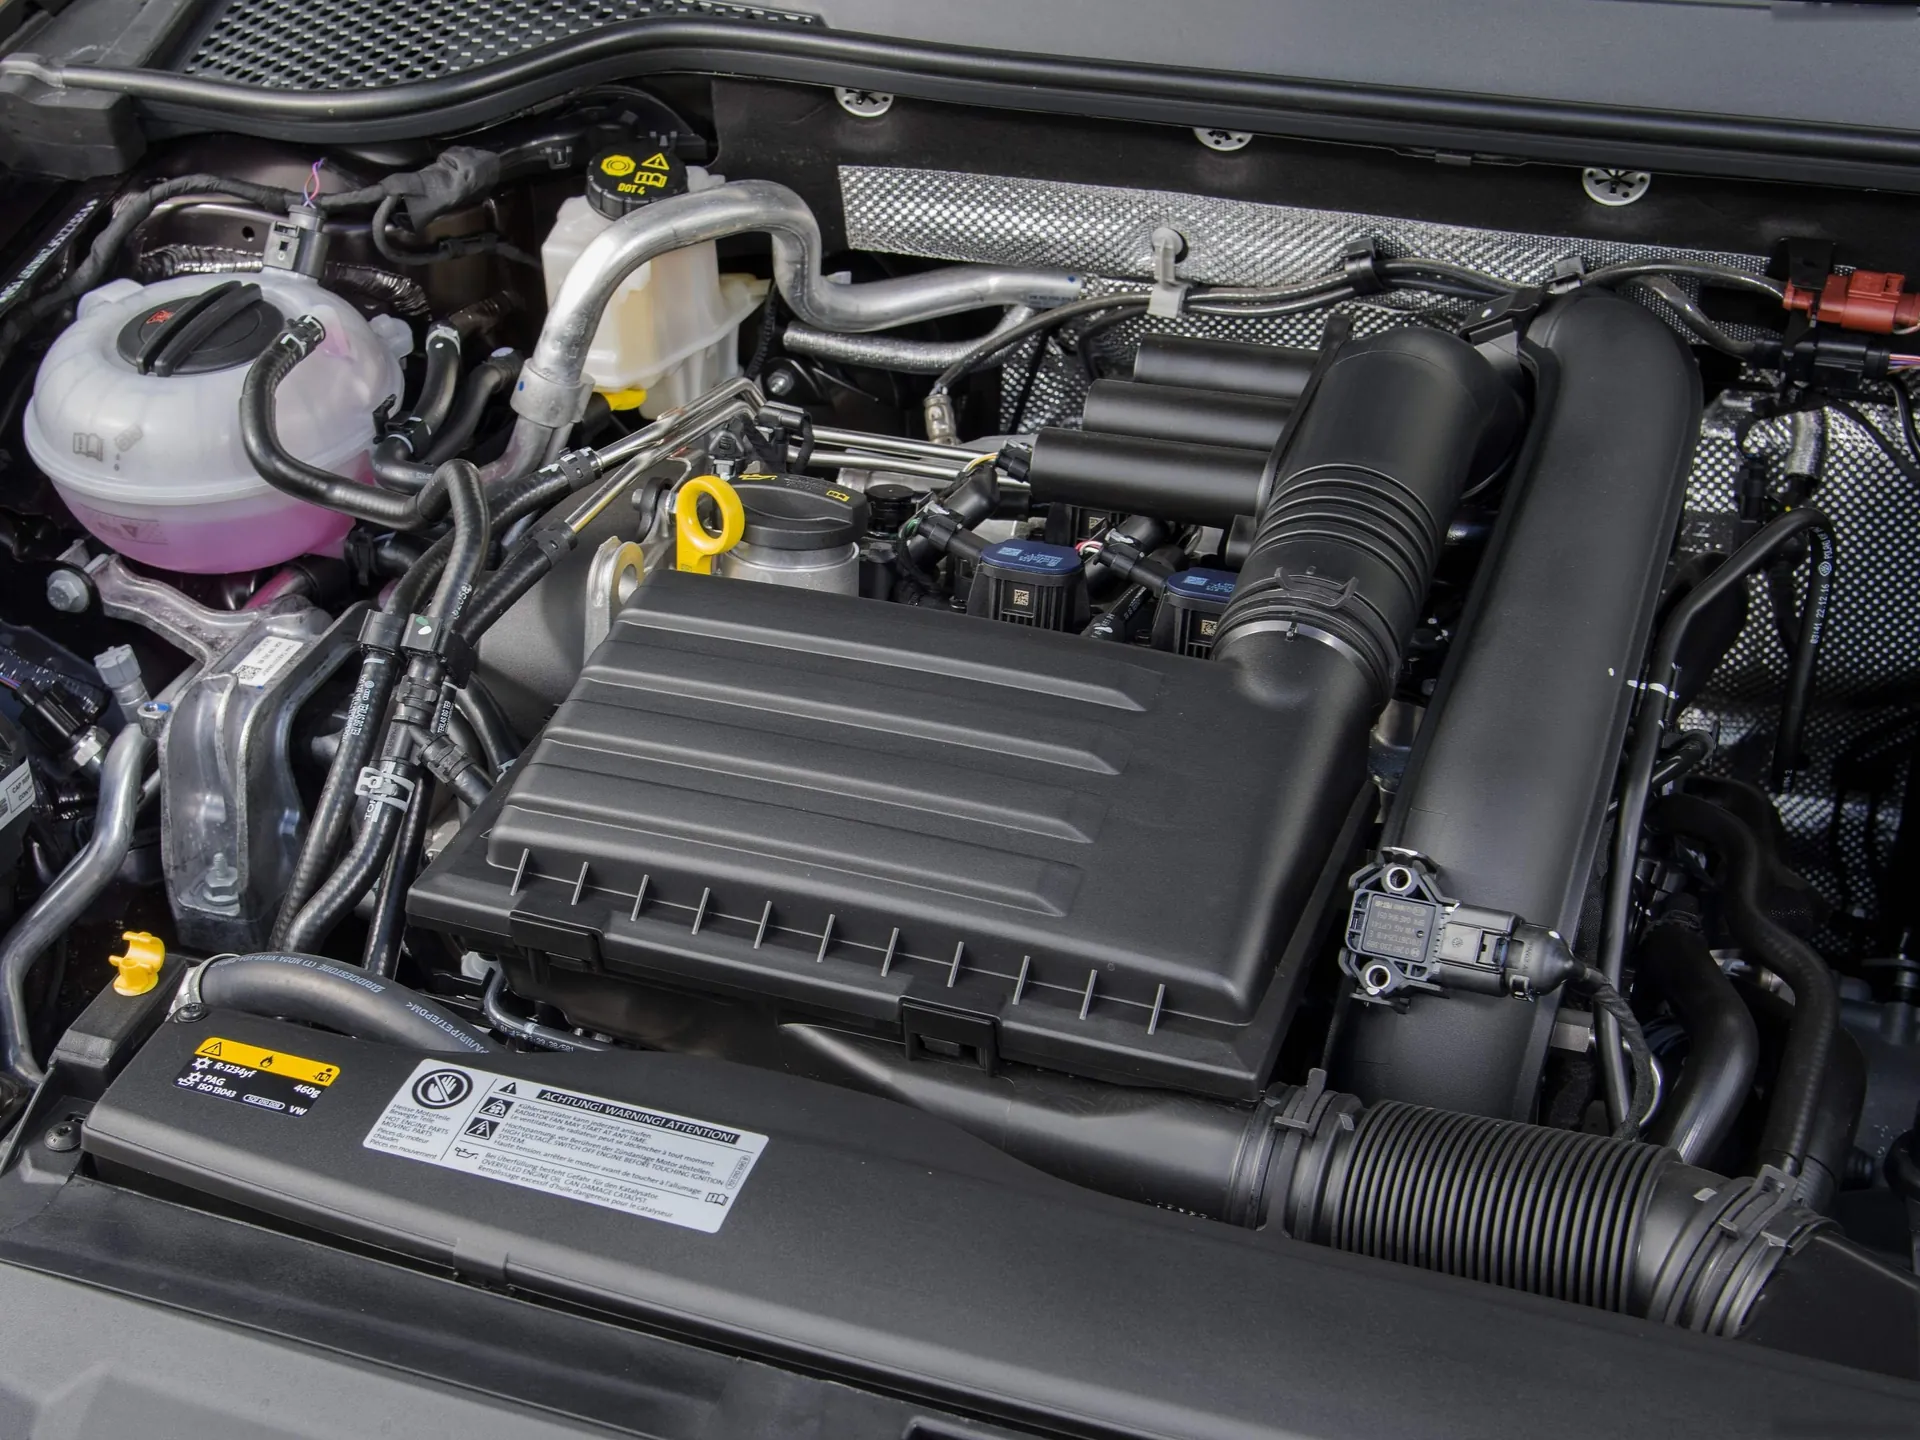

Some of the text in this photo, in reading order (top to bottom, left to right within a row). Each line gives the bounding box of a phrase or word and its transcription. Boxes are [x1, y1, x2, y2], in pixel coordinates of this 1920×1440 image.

[617, 183, 646, 196] DOT 4
[1816, 583, 1830, 618] 22.12.16
[12, 783, 21, 793] CAP
[317, 963, 386, 993] BRIDGESTONE
[197, 1082, 237, 1099] ISO 13043
[203, 1075, 226, 1086] PAG
[214, 1062, 321, 1099] R-1234yf 460g
[289, 1105, 308, 1116] VW
[388, 1108, 418, 1120] Bewegte
[415, 1109, 451, 1121] Motorteile
[515, 1108, 548, 1120] RADIATOR
[582, 1124, 602, 1132] START
[518, 1103, 572, 1119] Kühlerventilator
[589, 1120, 620, 1132] jederzeit
[542, 1091, 735, 1142] ACHTUNG! WARNING! ATTENTION!
[381, 1120, 433, 1137] MOVING PARTS
[401, 1118, 428, 1129] ENGINE
[428, 1125, 450, 1134] PARTS
[405, 1134, 430, 1144] moteur
[519, 1116, 556, 1128] ventilateur
[566, 1127, 597, 1138] radiateur
[598, 1135, 614, 1143] peut
[624, 1141, 661, 1154] déclencher
[668, 1151, 683, 1159] tout
[398, 1145, 438, 1159] mouvement
[494, 1139, 515, 1148] Haute
[575, 1159, 600, 1169] moteur
[602, 1165, 622, 1174] avant
[631, 1172, 659, 1184] toucher
[501, 1128, 520, 1136] HIGH
[554, 1140, 581, 1151] SWITCH
[596, 1150, 623, 1161] ENGINE
[624, 1157, 650, 1167] BEFORE
[651, 1163, 690, 1177] TOUCHING
[691, 1173, 724, 1185] IGNITION
[570, 1137, 602, 1149] Berühren
[614, 1148, 655, 1163] Zündanlage
[656, 1158, 678, 1167] Motor
[481, 1158, 522, 1172] OVERFILLED
[522, 1168, 549, 1179] ENGINE
[564, 1179, 580, 1187] CAN
[580, 1183, 613, 1195] DAMAGE
[539, 1165, 566, 1176] besteht
[566, 1172, 591, 1182] Gefahr
[476, 1164, 520, 1181] Remplissage
[520, 1175, 549, 1187] excessif
[572, 1188, 611, 1203] dangereux
[610, 1198, 628, 1207] pour
